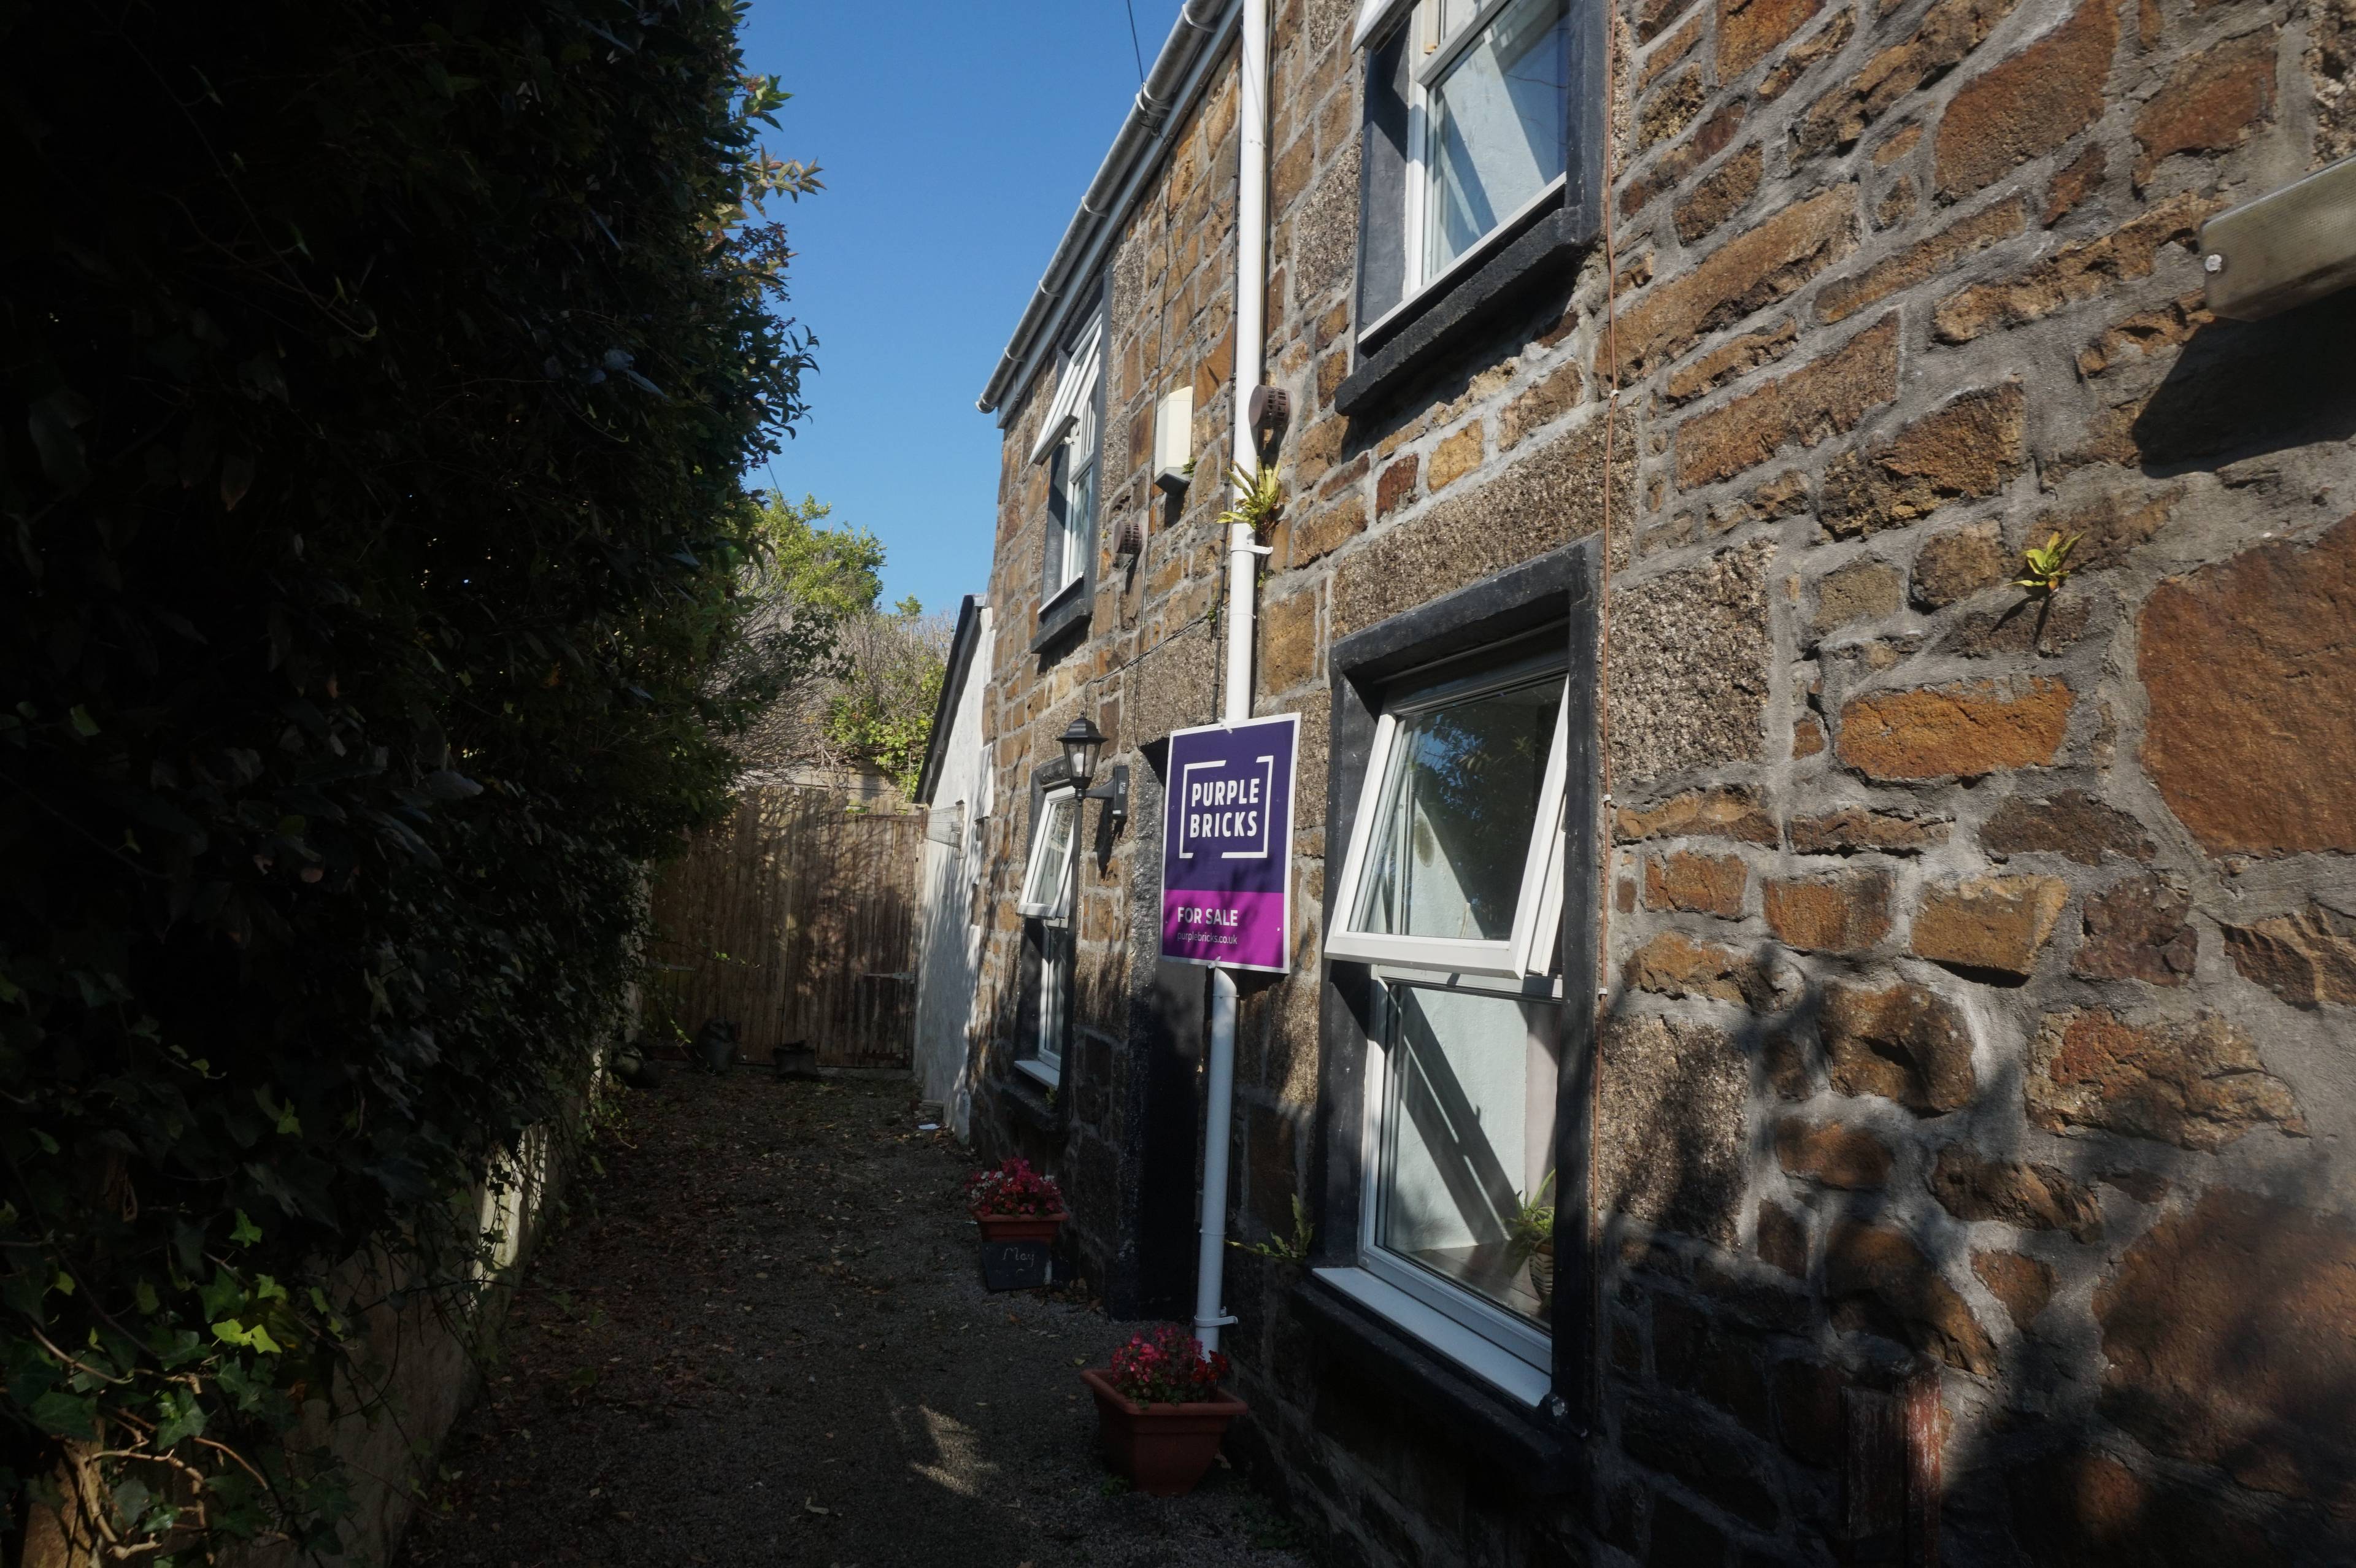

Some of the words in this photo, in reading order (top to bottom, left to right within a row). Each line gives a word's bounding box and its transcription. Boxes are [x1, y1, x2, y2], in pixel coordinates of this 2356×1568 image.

[1191, 778, 1260, 807] PURPLE
[1190, 810, 1257, 838] BRICKS
[1177, 907, 1202, 924] FOR
[1206, 909, 1238, 926] SALE
[1177, 932, 1238, 945] purplebricks.co.uk
